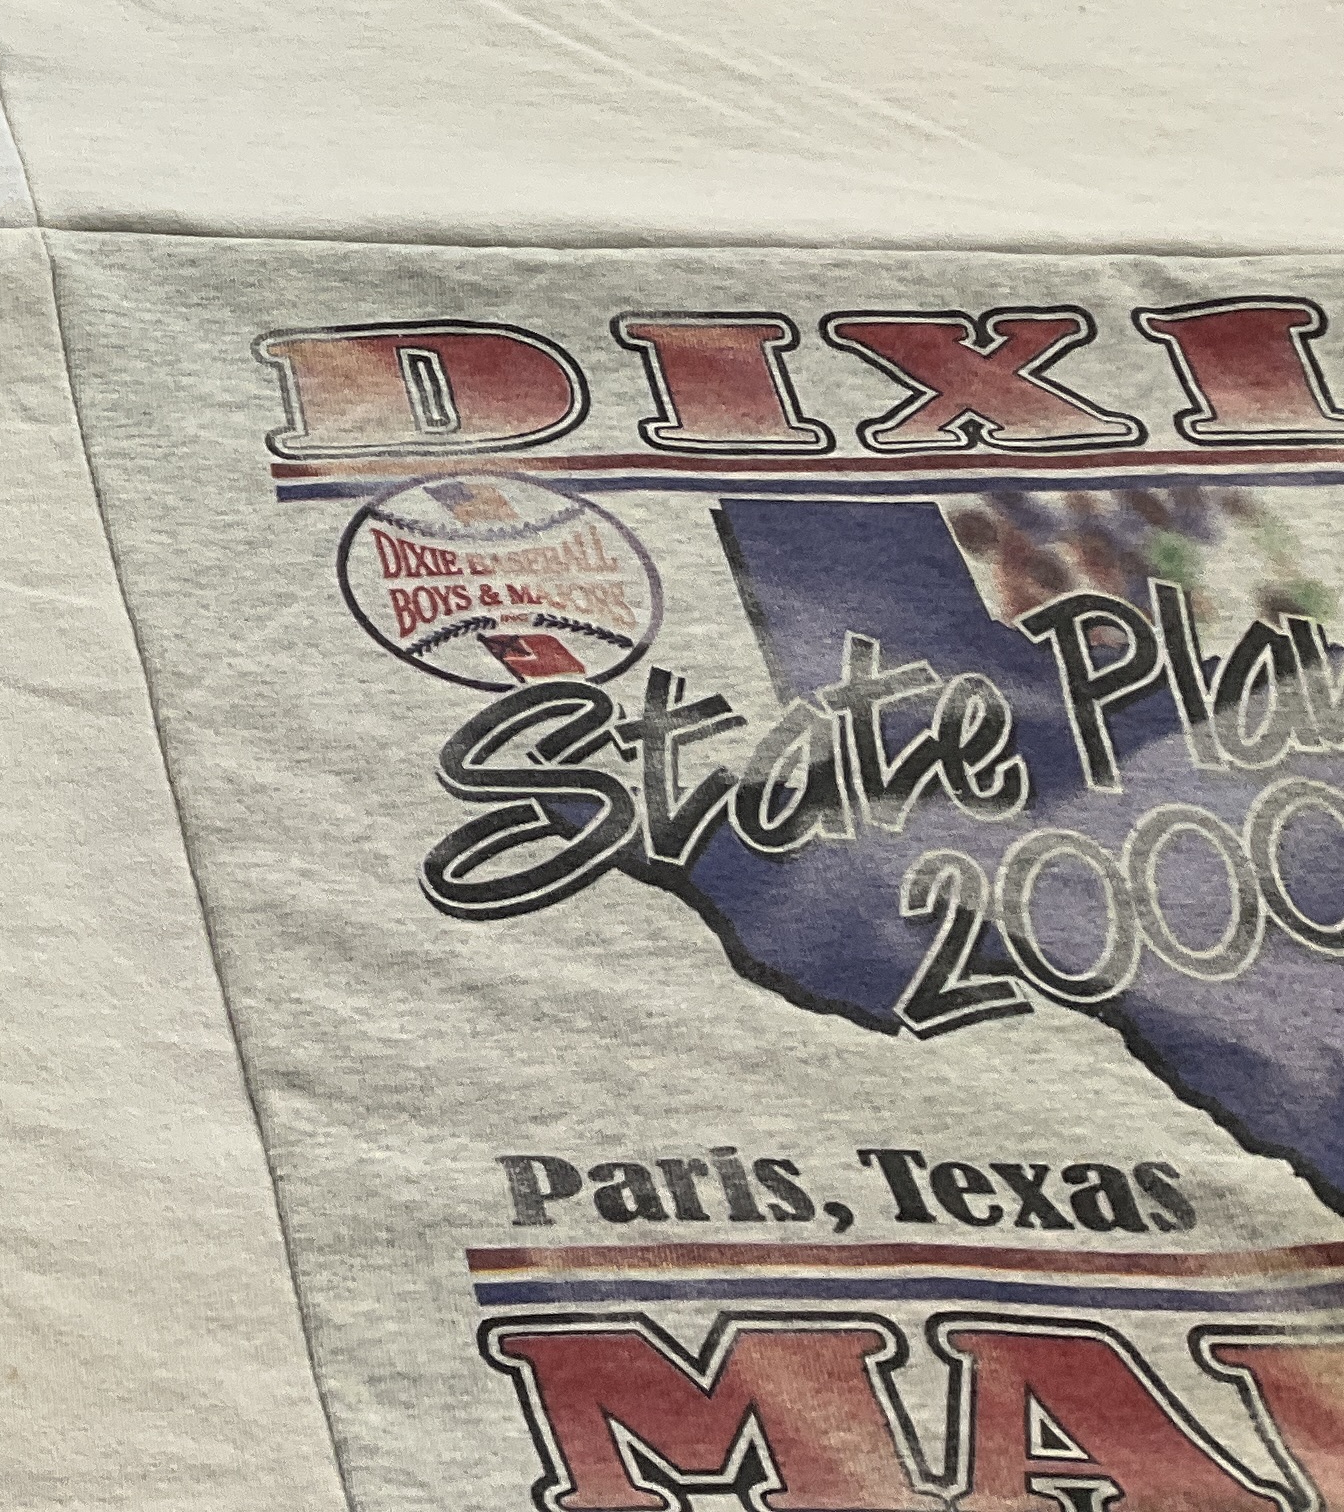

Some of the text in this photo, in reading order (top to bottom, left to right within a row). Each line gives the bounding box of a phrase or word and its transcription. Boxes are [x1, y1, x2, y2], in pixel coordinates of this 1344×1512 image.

[252, 300, 1344, 458] DIXI
[370, 524, 618, 579] DIXIE BASEBALL
[390, 580, 637, 638] BOYS & MAJORS
[420, 635, 1030, 922] State
[899, 776, 1344, 1040] 2000
[499, 1146, 1198, 1237] Paris, Texas
